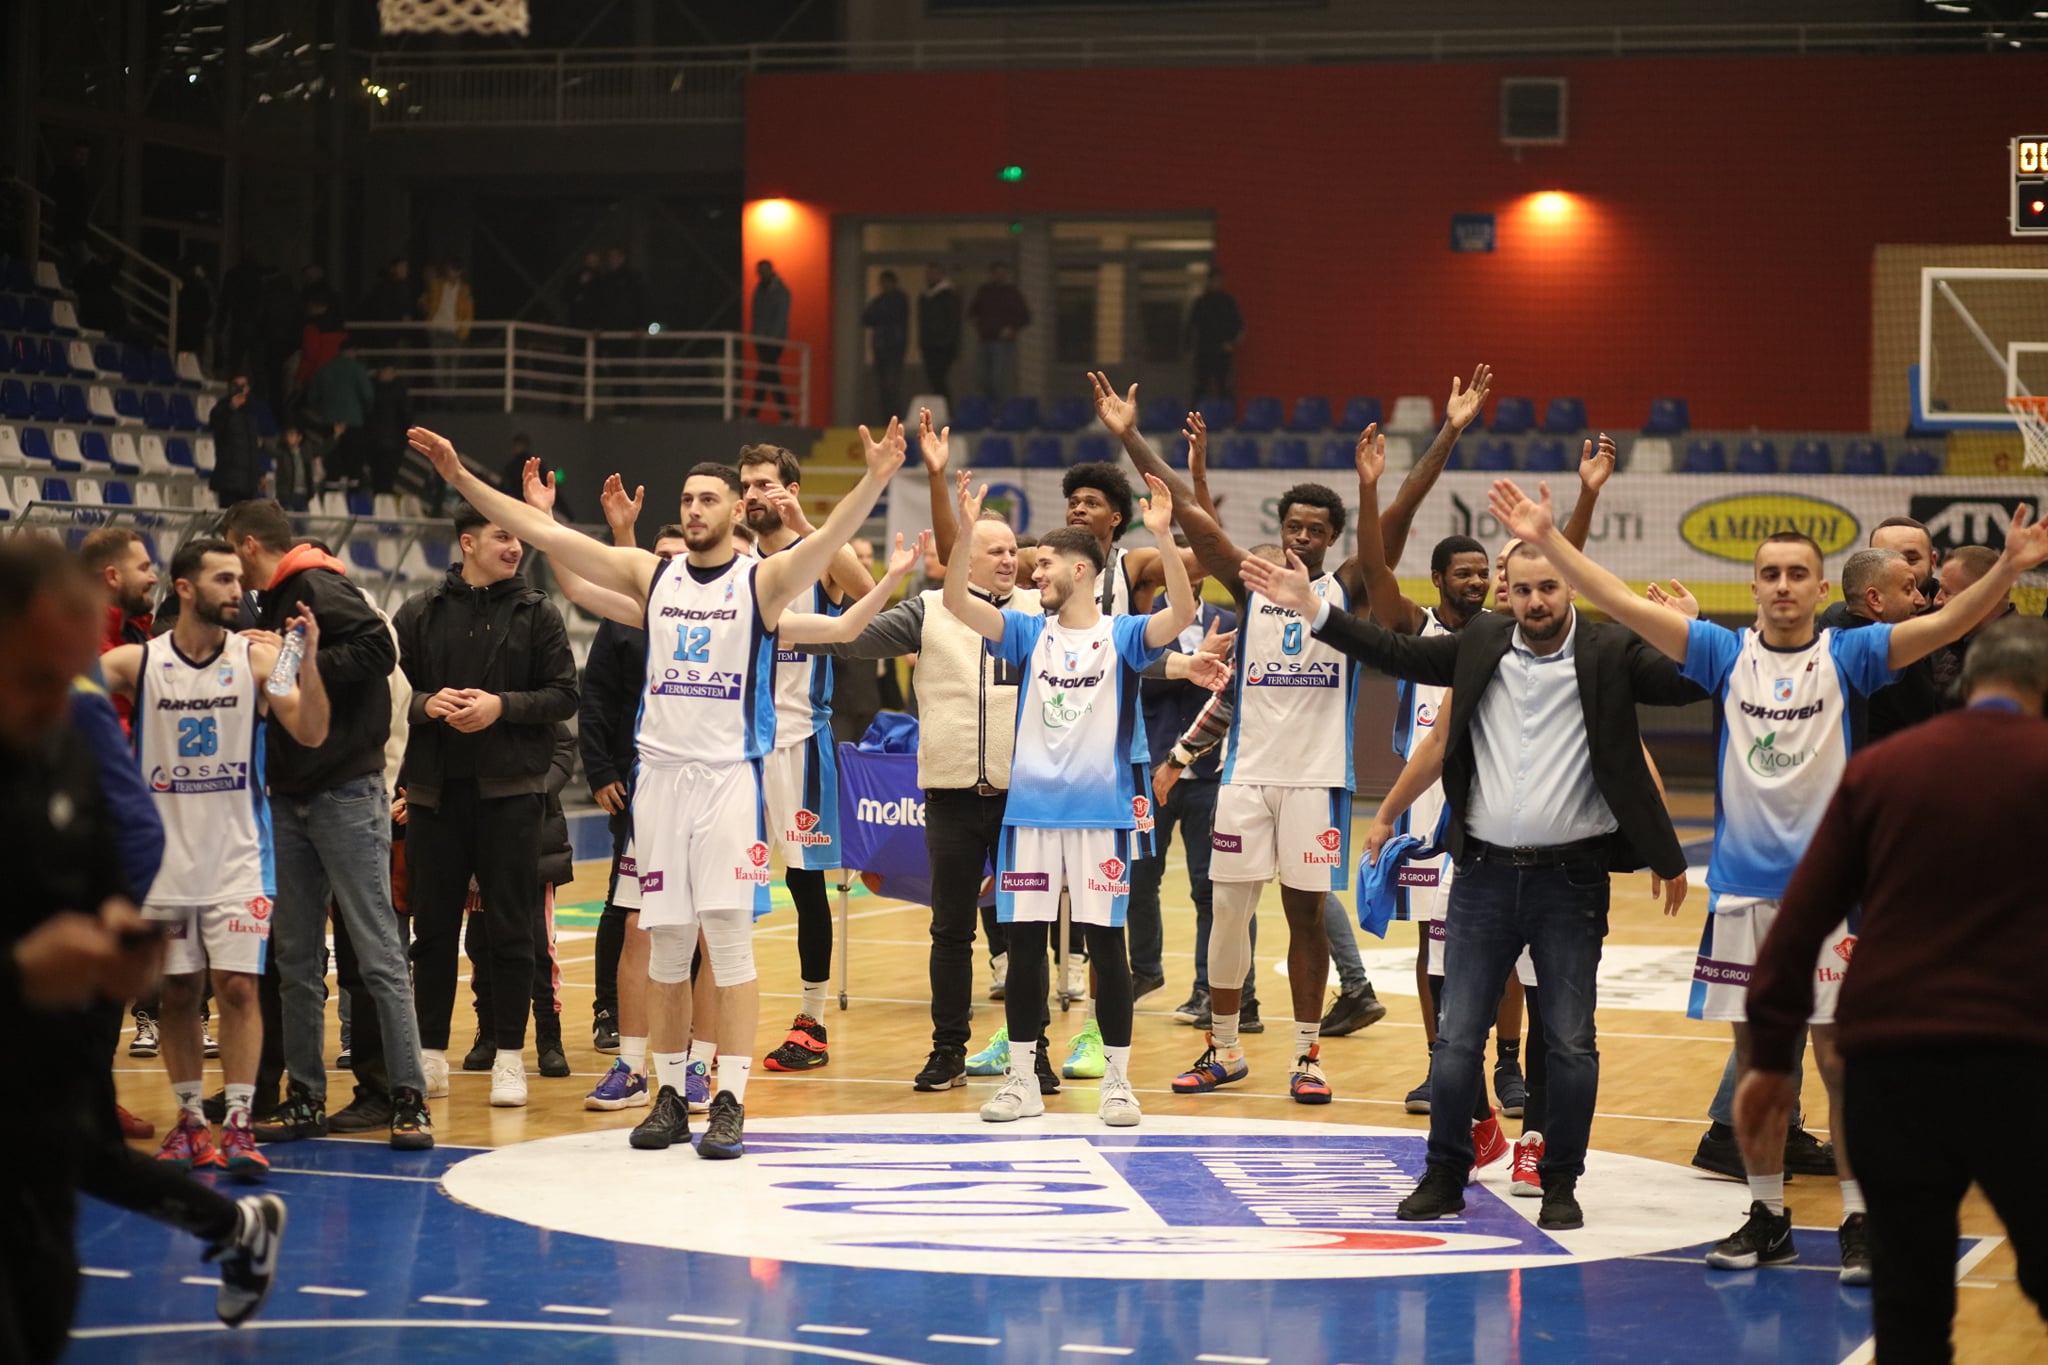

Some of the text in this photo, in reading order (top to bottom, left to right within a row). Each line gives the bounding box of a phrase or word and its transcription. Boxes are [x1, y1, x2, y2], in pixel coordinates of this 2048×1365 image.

[673, 624, 711, 663] 12
[1282, 622, 1302, 656] 0
[1266, 662, 1324, 673] OSA
[664, 668, 723, 683] OSA
[1266, 676, 1326, 686] TERMOSISTEM
[664, 685, 725, 698] TERMOSISTEM
[178, 716, 218, 757] 26
[172, 763, 230, 778] OSA
[857, 797, 926, 827] molte
[1408, 873, 1436, 882] GROUP
[1721, 969, 1751, 981] GROU
